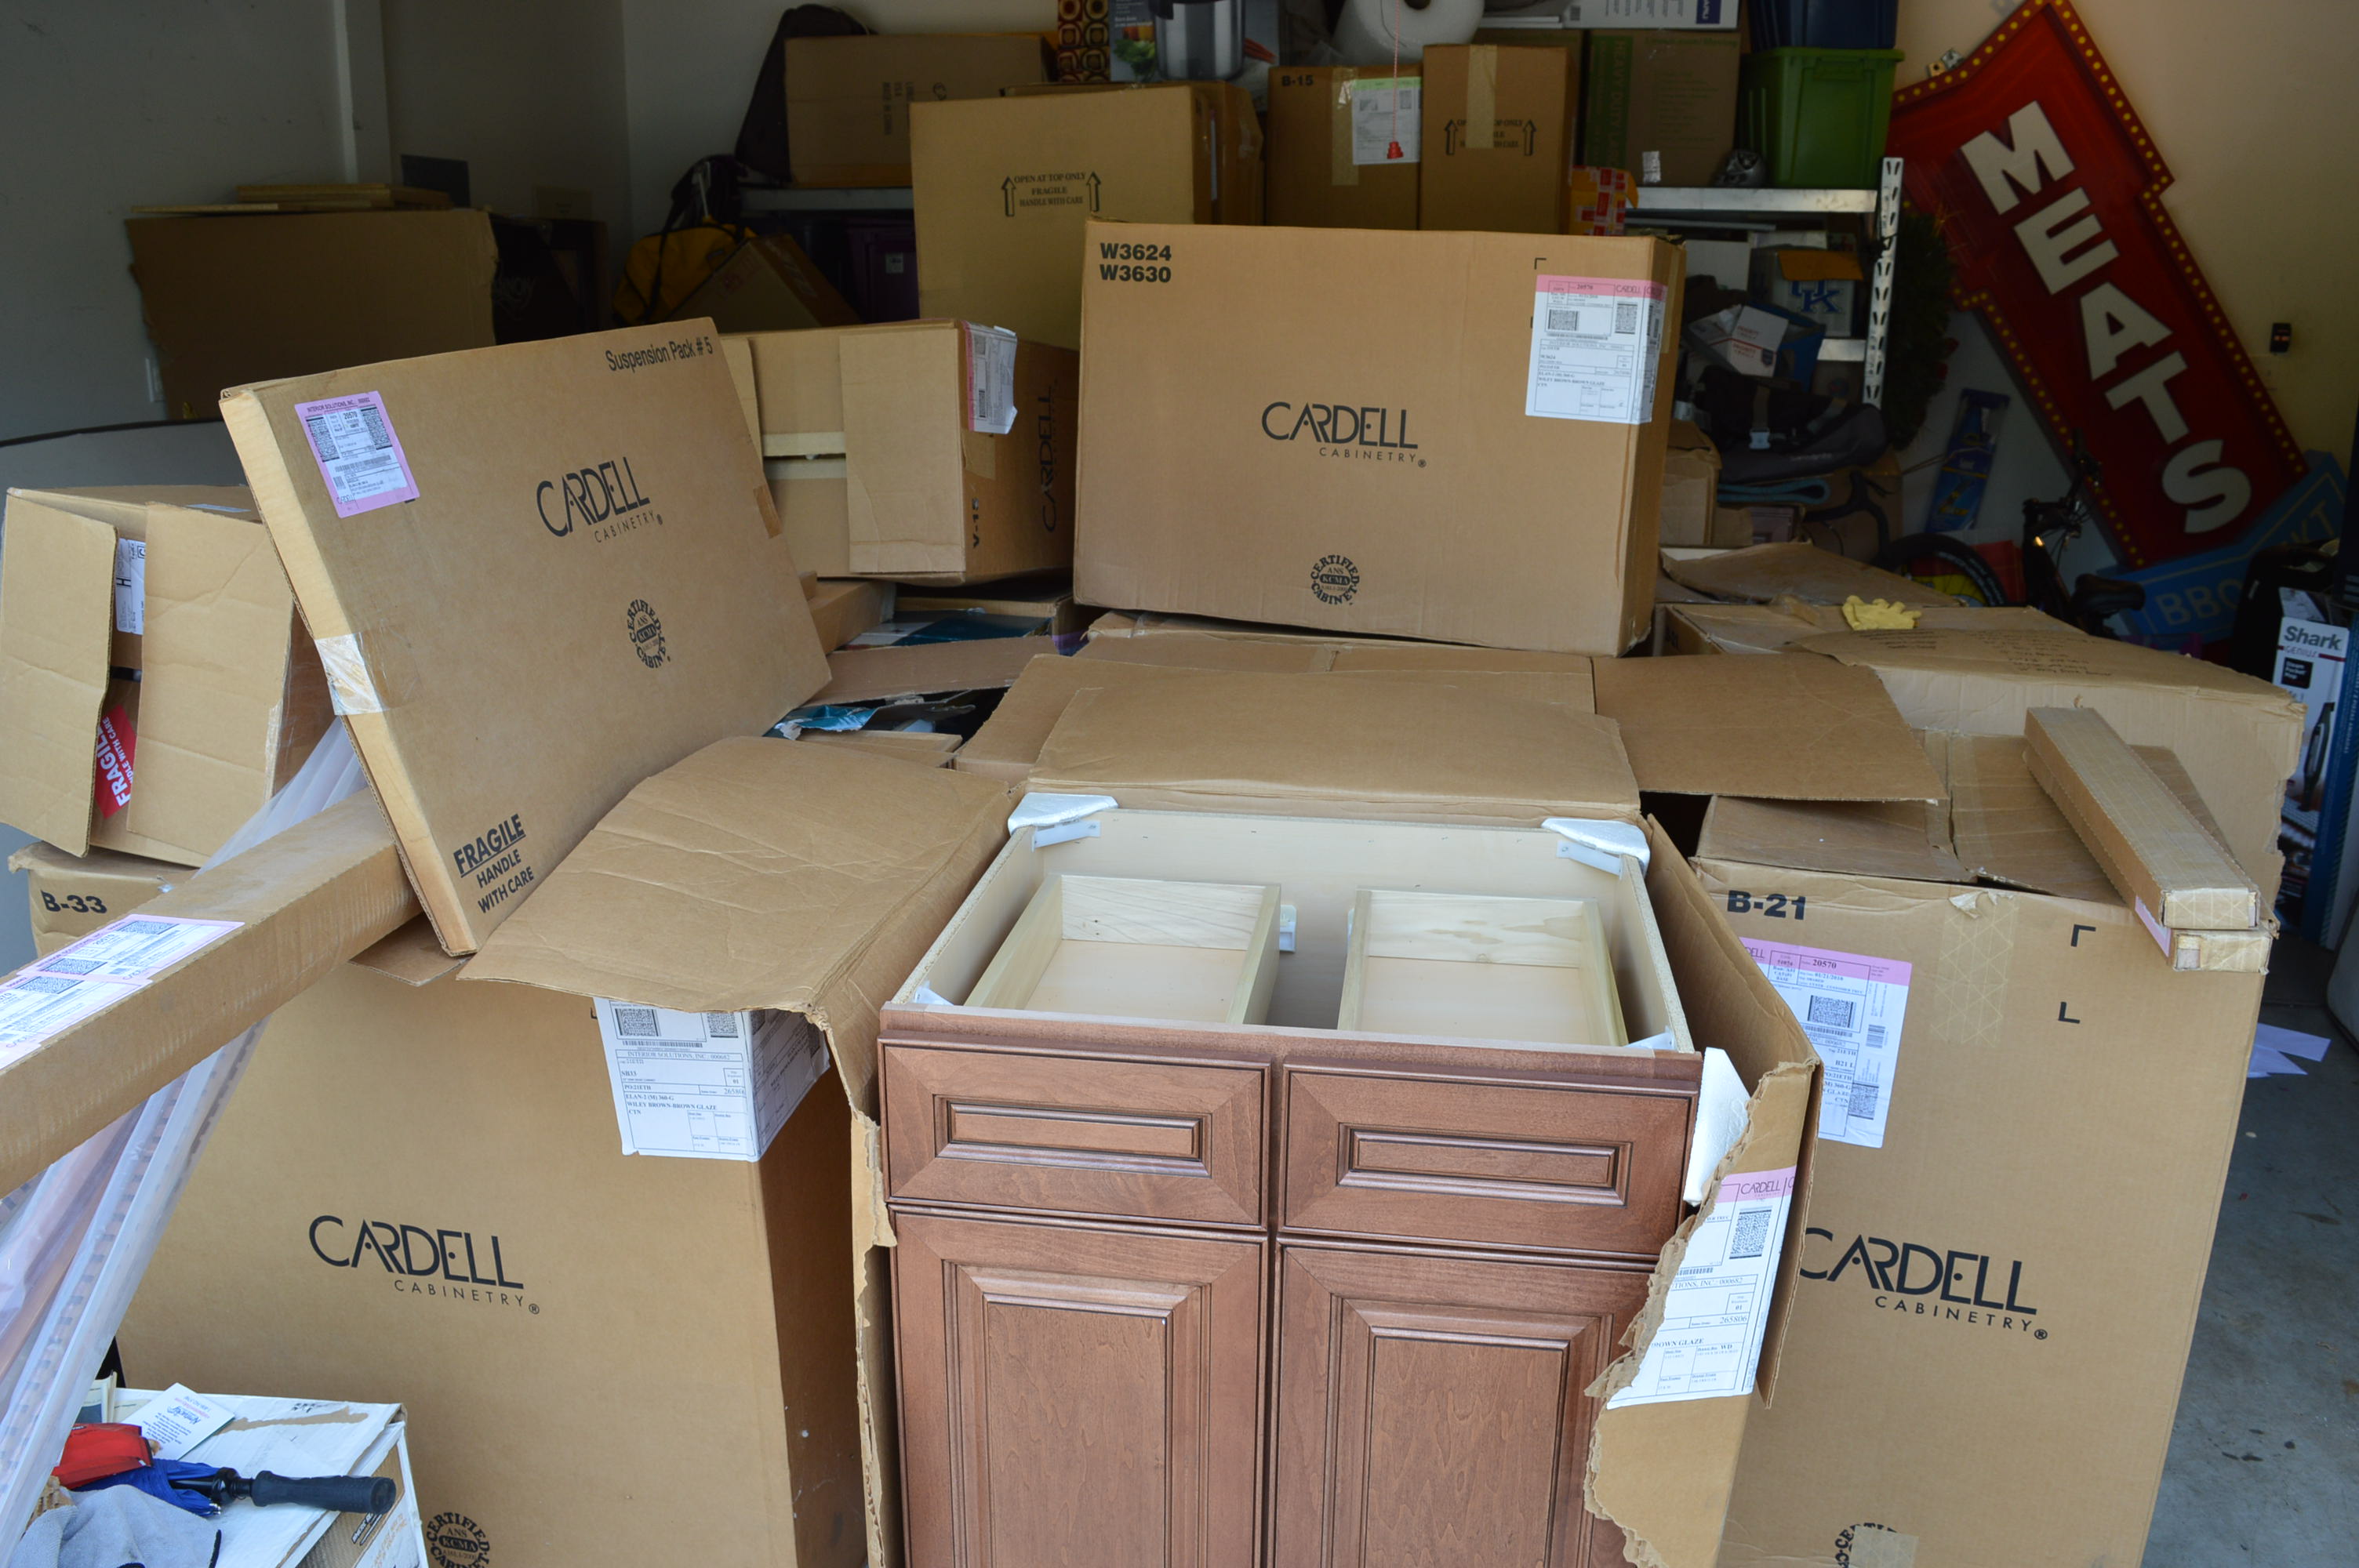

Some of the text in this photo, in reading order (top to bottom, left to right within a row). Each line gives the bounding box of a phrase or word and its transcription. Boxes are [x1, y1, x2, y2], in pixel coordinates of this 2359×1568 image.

[1281, 75, 1314, 86] B-15
[1031, 187, 1068, 195] FRAGILE
[1048, 172, 1064, 182] TOP
[1065, 172, 1086, 180] ONLY
[1020, 195, 1083, 207] HANDLE WITH CARE
[1100, 242, 1172, 261] W3624
[1100, 264, 1172, 283] W3630
[1960, 100, 2252, 534] MEATS
[605, 336, 714, 373] Suspension Pack # 5
[1261, 401, 1419, 450] CARDELL
[1038, 387, 1056, 533] CARDELL
[536, 456, 651, 538] CARDELL
[1310, 554, 1360, 584] CERTIFIED
[2284, 626, 2343, 652] Shark
[102, 717, 117, 739] CARE
[112, 739, 126, 762] WITH
[453, 813, 525, 875] FRAGILE
[476, 849, 522, 888] HANDLE
[41, 890, 107, 914] B-33
[478, 866, 535, 914] WITH CARE
[1727, 889, 1807, 920] B-21
[1812, 959, 1837, 969] 20570
[1740, 1180, 1780, 1195] CARDELL
[308, 1214, 524, 1290] CARDELL
[1800, 1227, 2037, 1316] CARDELL
[394, 1279, 524, 1308] CABINETRY
[1875, 1295, 2033, 1332] CABINETRY
[1678, 1338, 1705, 1346] GLAZE
[426, 1512, 490, 1552] CERTIFIED
